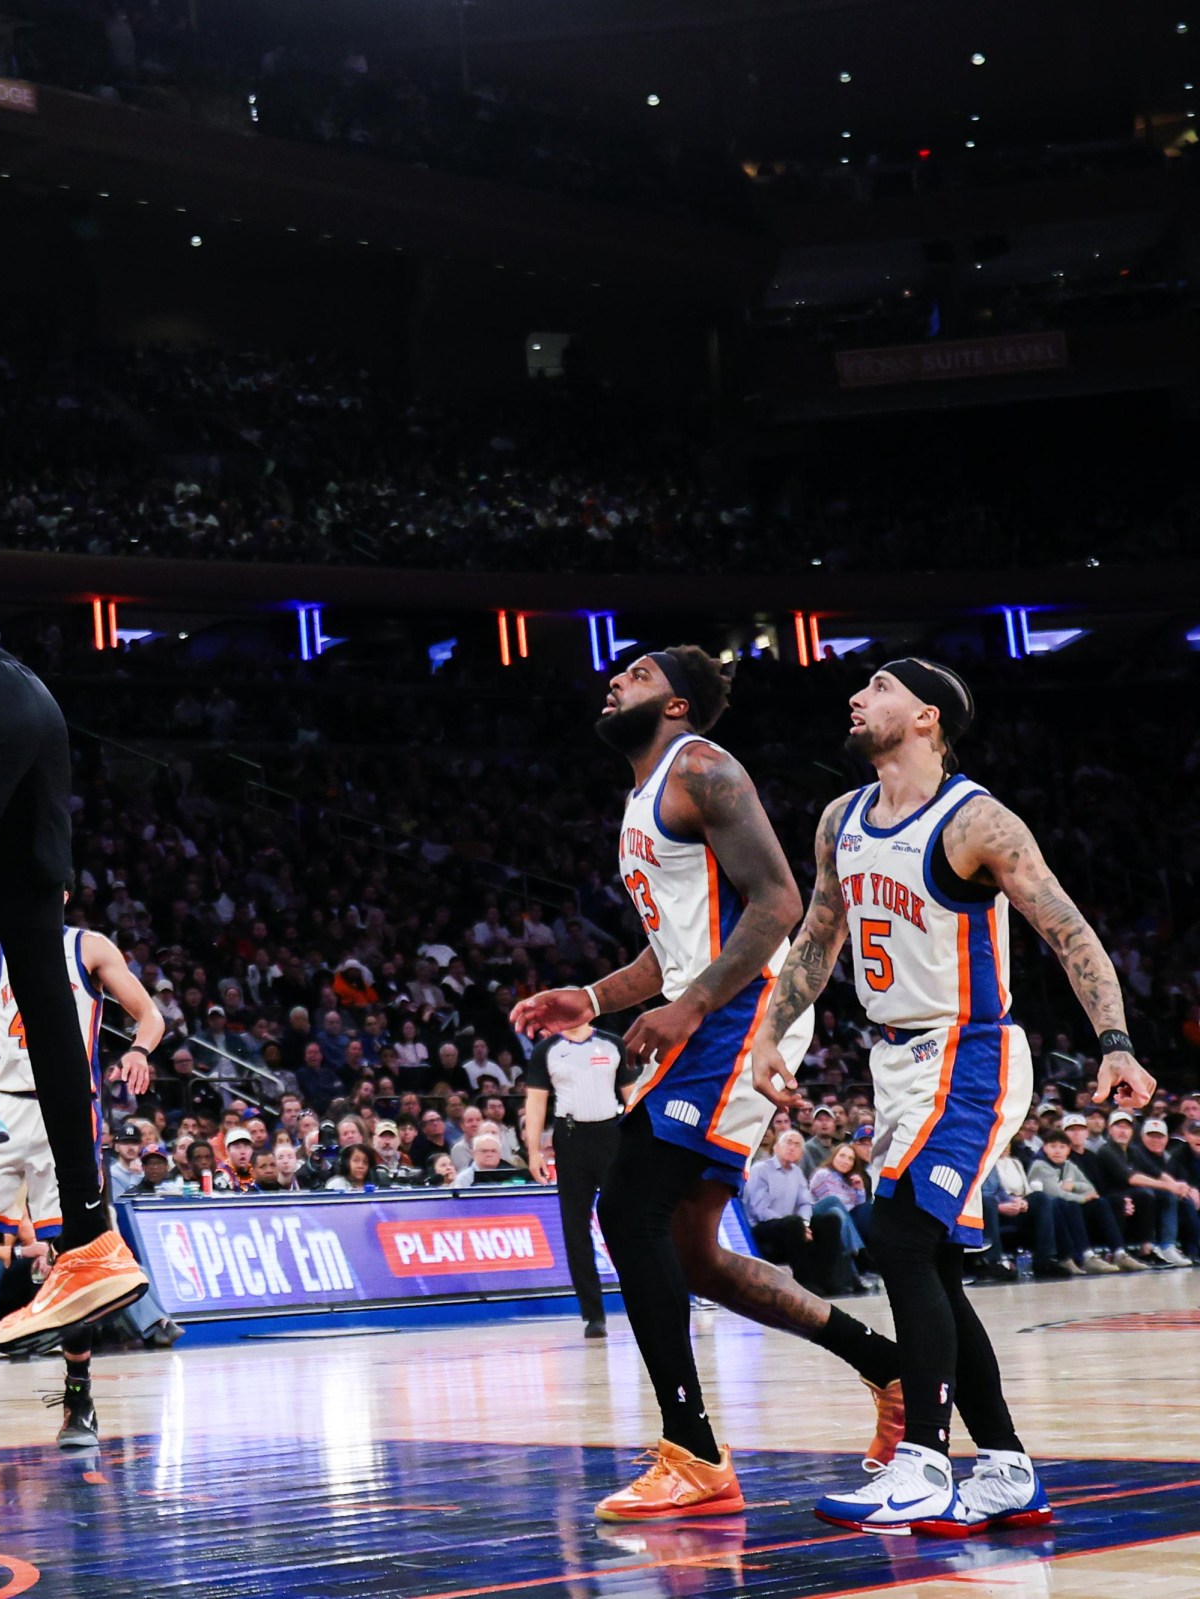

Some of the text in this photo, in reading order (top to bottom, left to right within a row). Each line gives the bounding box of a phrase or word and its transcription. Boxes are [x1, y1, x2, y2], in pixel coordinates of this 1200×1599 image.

[922, 352, 985, 371] SUITE
[993, 343, 1060, 365] LEVEL
[841, 872, 927, 935] EW YORK
[860, 917, 895, 993] 5
[189, 1216, 354, 1298] Pick'Em
[394, 1230, 466, 1265] PLAY
[468, 1227, 535, 1261] NOW
